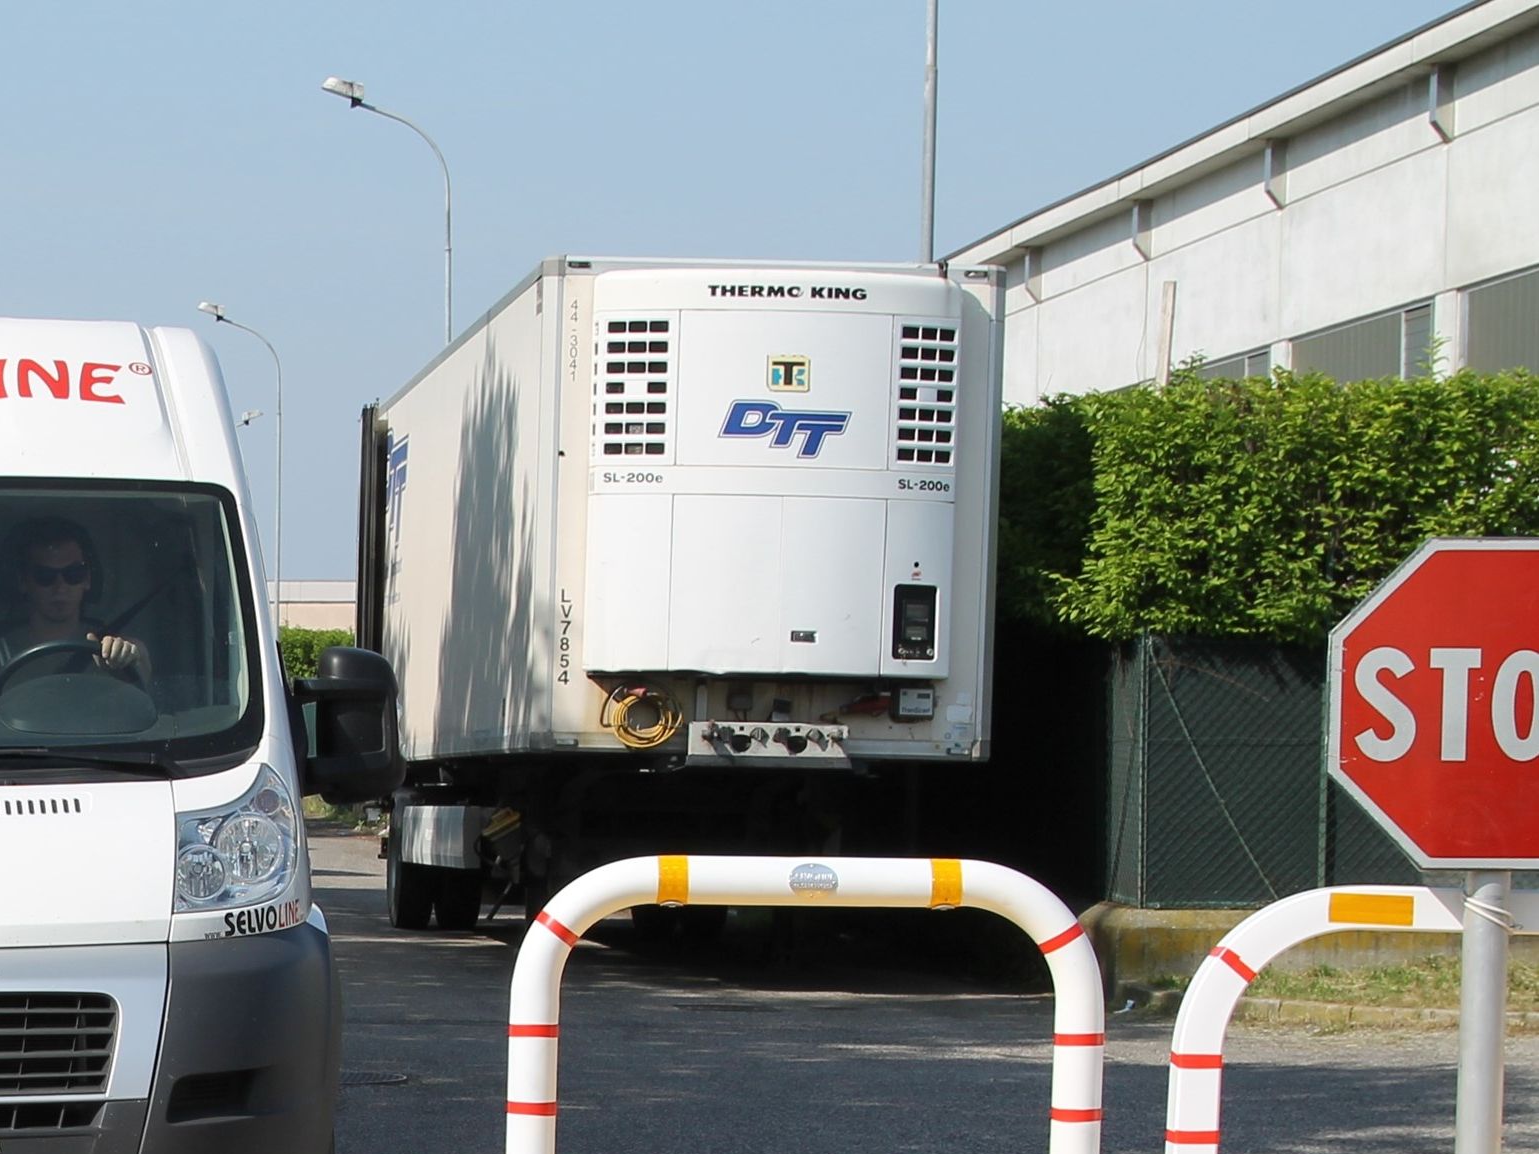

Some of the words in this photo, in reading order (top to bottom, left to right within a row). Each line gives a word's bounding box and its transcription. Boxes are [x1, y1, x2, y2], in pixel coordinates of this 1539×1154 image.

[708, 285, 804, 298] THERMO
[810, 287, 867, 300] KING
[718, 399, 852, 459] DTT
[603, 472, 664, 483] SL-200e
[898, 479, 950, 492] SL-200e
[557, 588, 572, 686] LV7854
